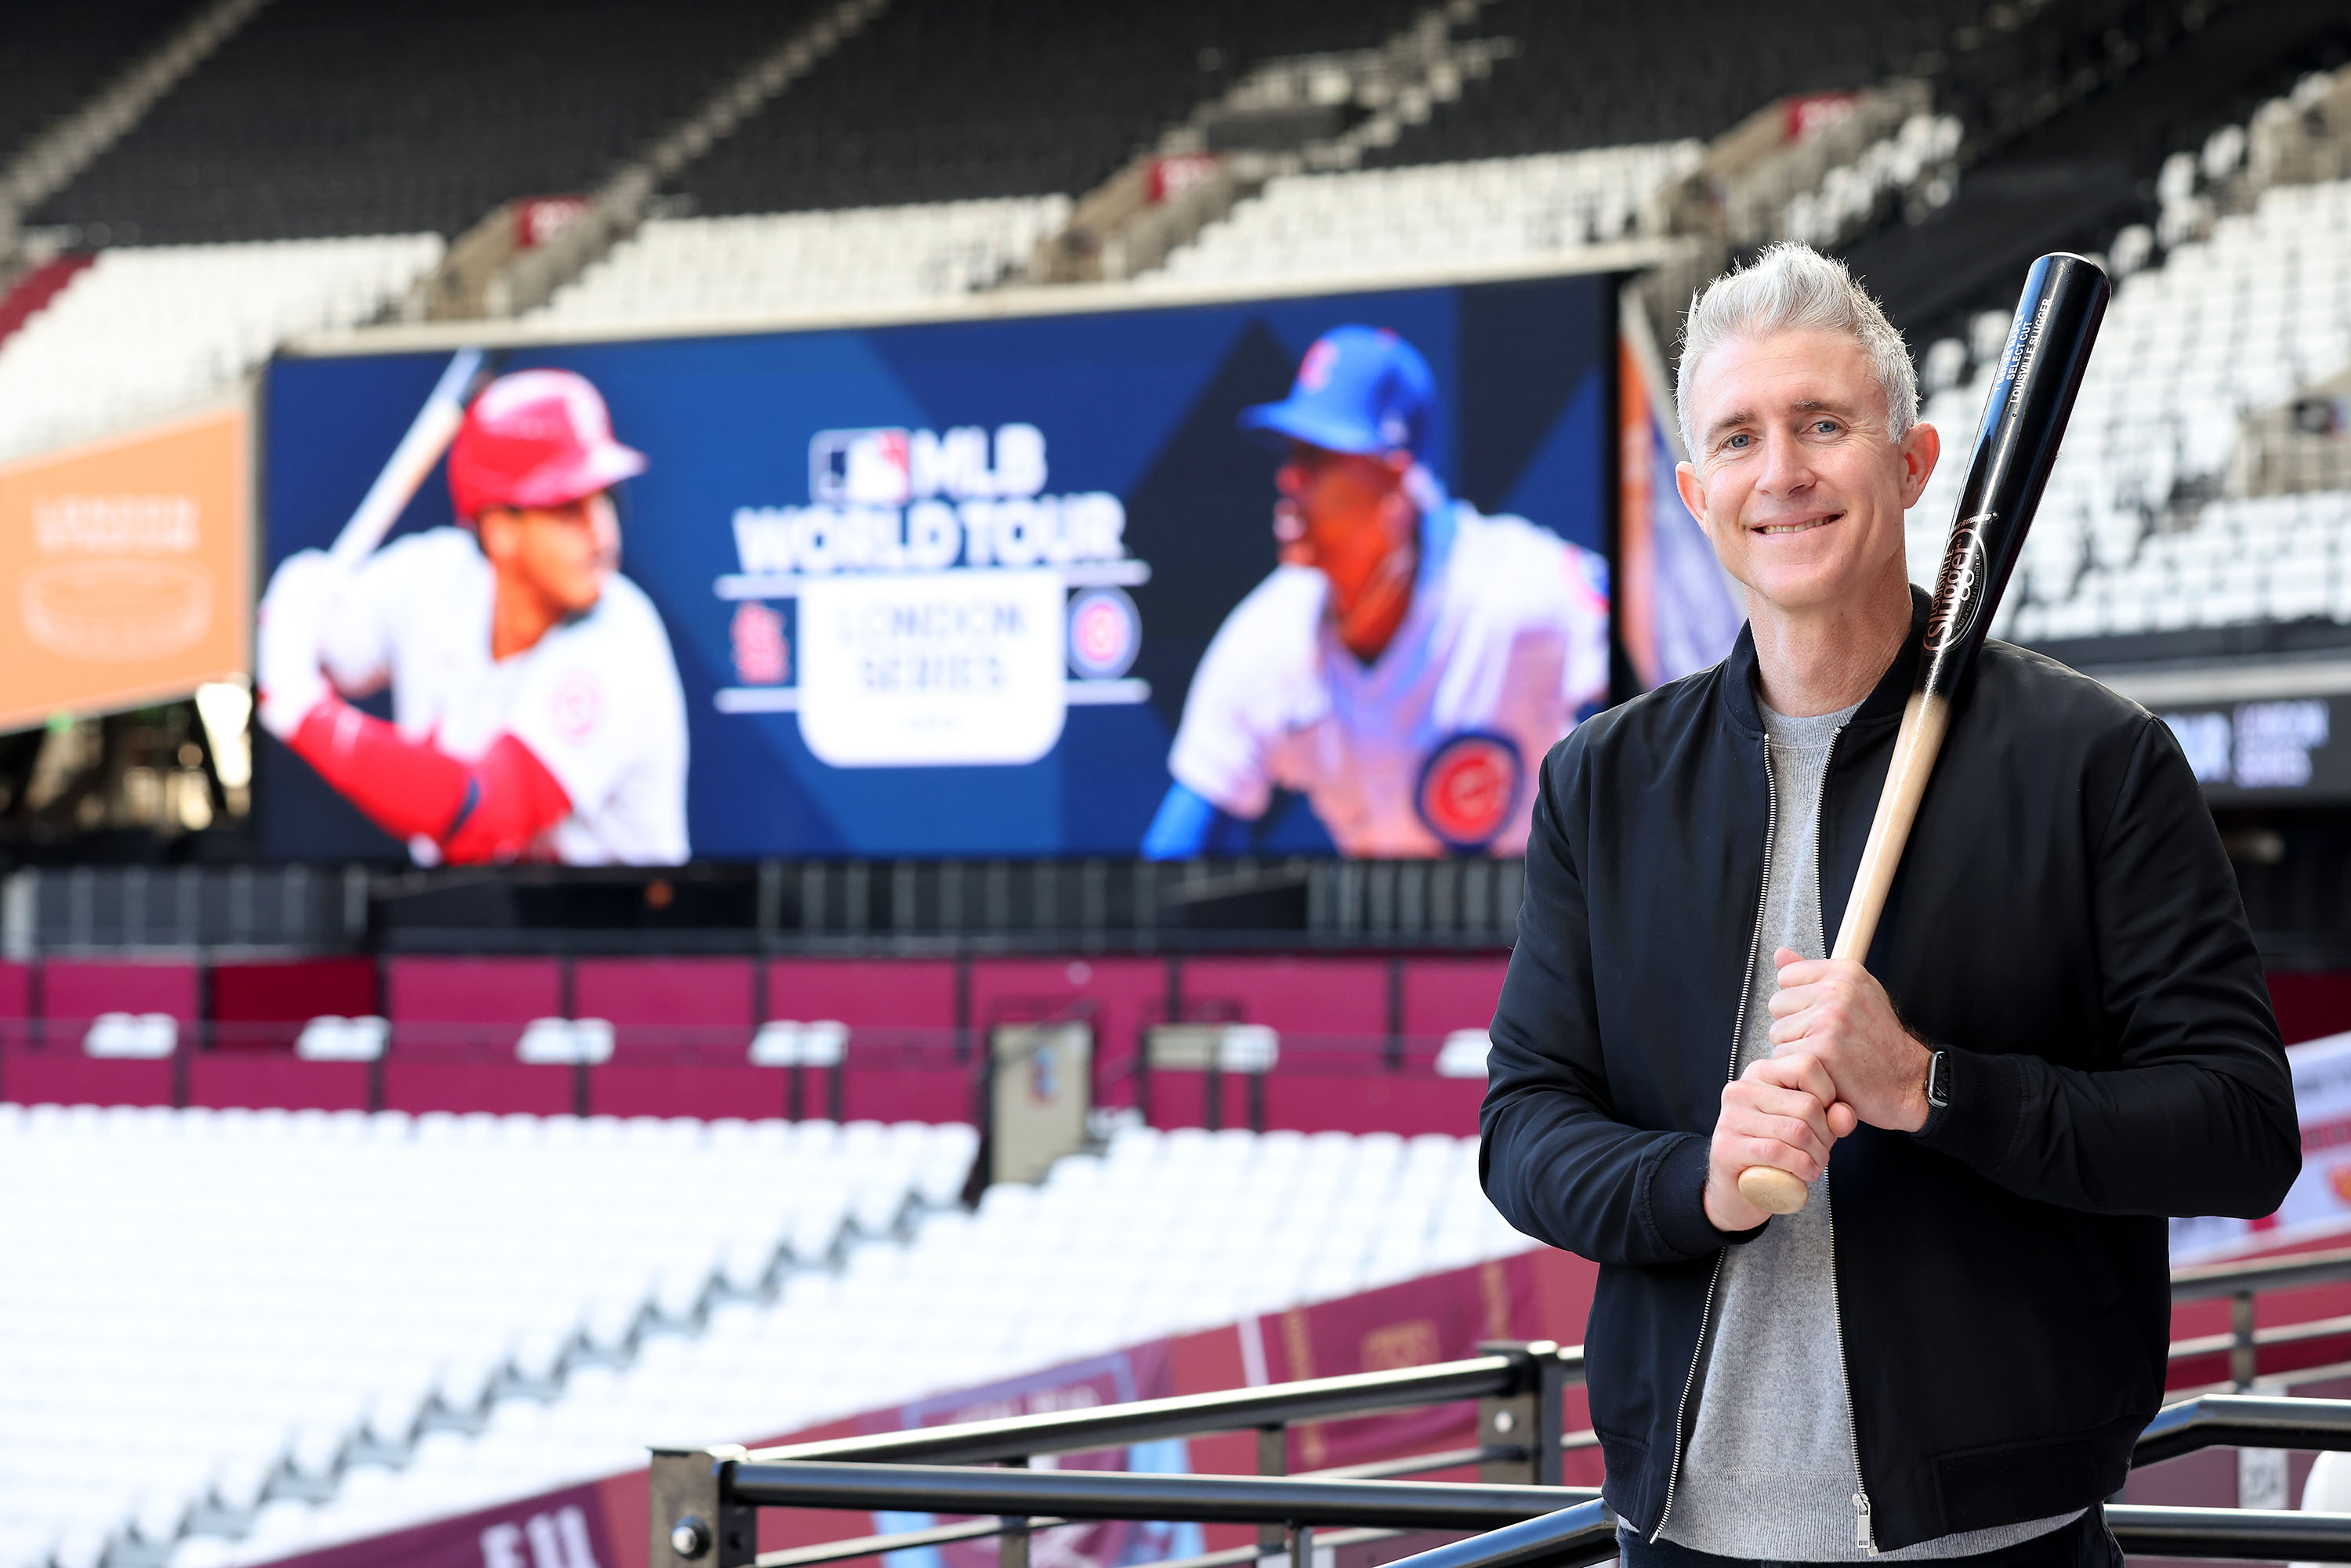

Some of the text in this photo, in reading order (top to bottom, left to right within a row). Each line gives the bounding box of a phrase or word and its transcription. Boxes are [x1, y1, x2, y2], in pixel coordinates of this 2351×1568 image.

[2006, 321, 2032, 380] SELECT CUT
[2009, 313, 2025, 347] MAPLE
[2010, 298, 2051, 403] LOUISVILLE SLUGGER
[909, 422, 1049, 498] MLB
[732, 492, 1128, 573] WORLD TOUR
[1928, 544, 1975, 638] Slugger
[1930, 549, 1954, 616] LOUISVILLE
[1957, 618, 1966, 629] MADE
